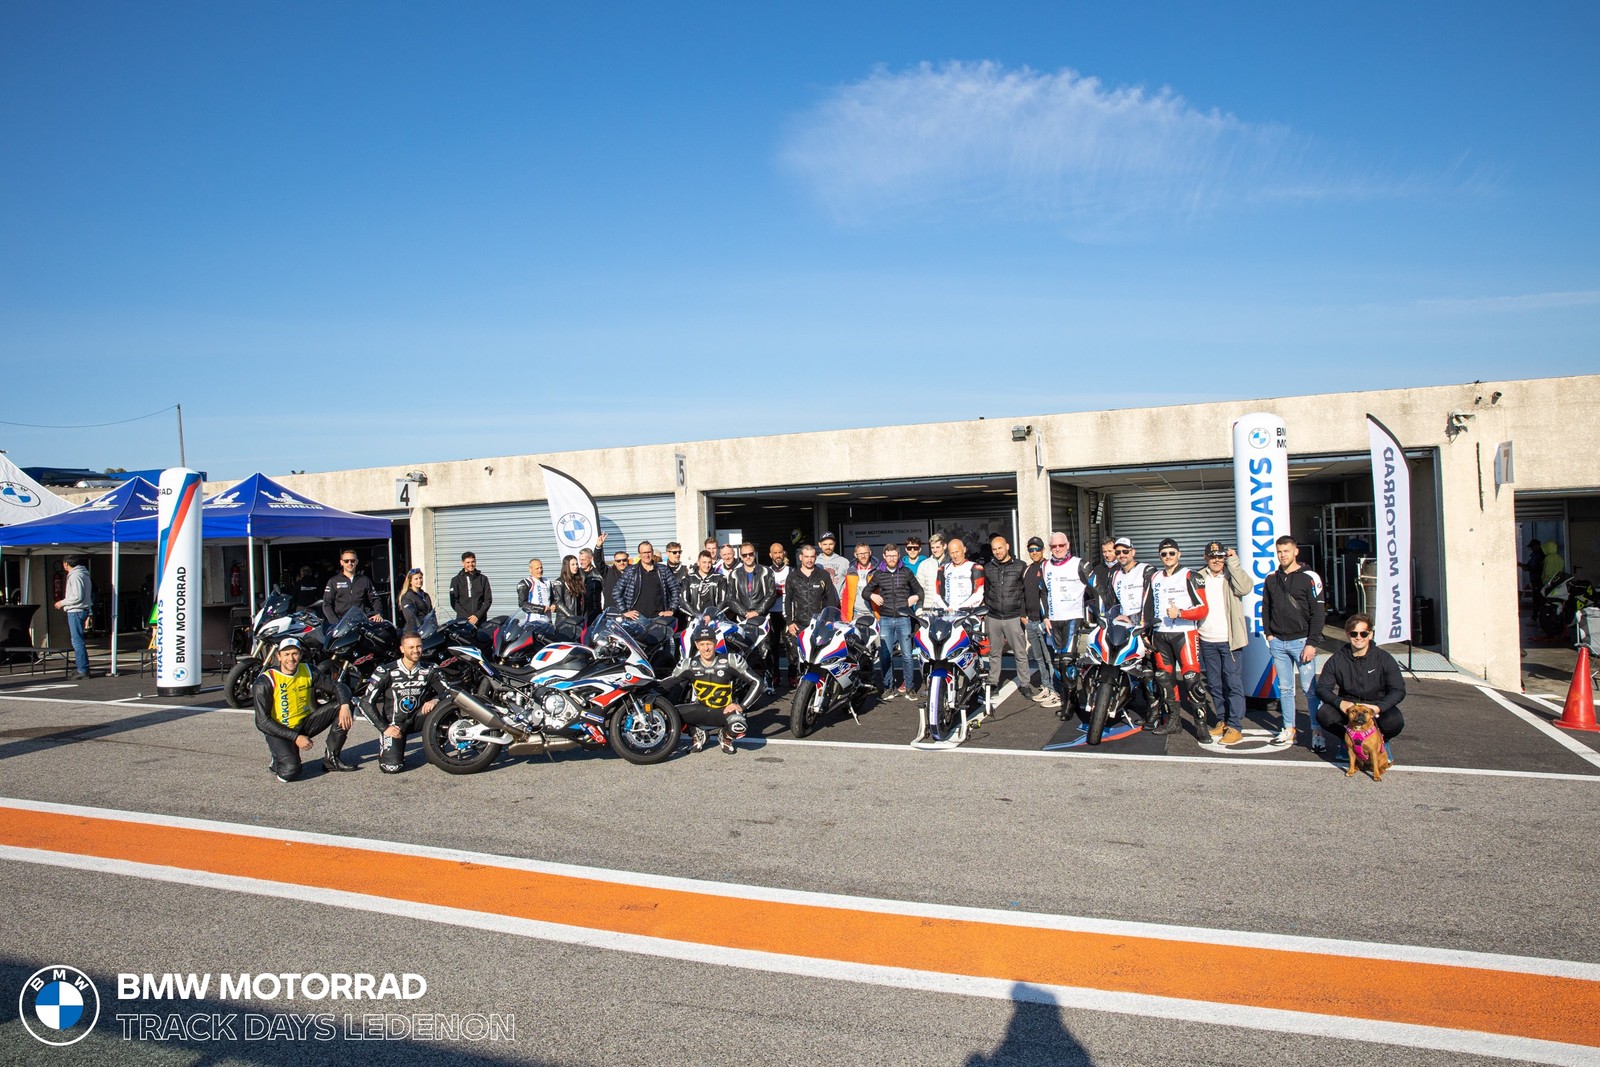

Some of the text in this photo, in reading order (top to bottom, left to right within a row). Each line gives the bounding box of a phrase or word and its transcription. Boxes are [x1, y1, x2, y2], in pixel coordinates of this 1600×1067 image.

[678, 460, 685, 486] 5
[400, 483, 410, 507] 4
[176, 566, 186, 663] BMW MOTORRAD
[279, 682, 289, 726] ACKDAYS
[694, 679, 734, 709] 78
